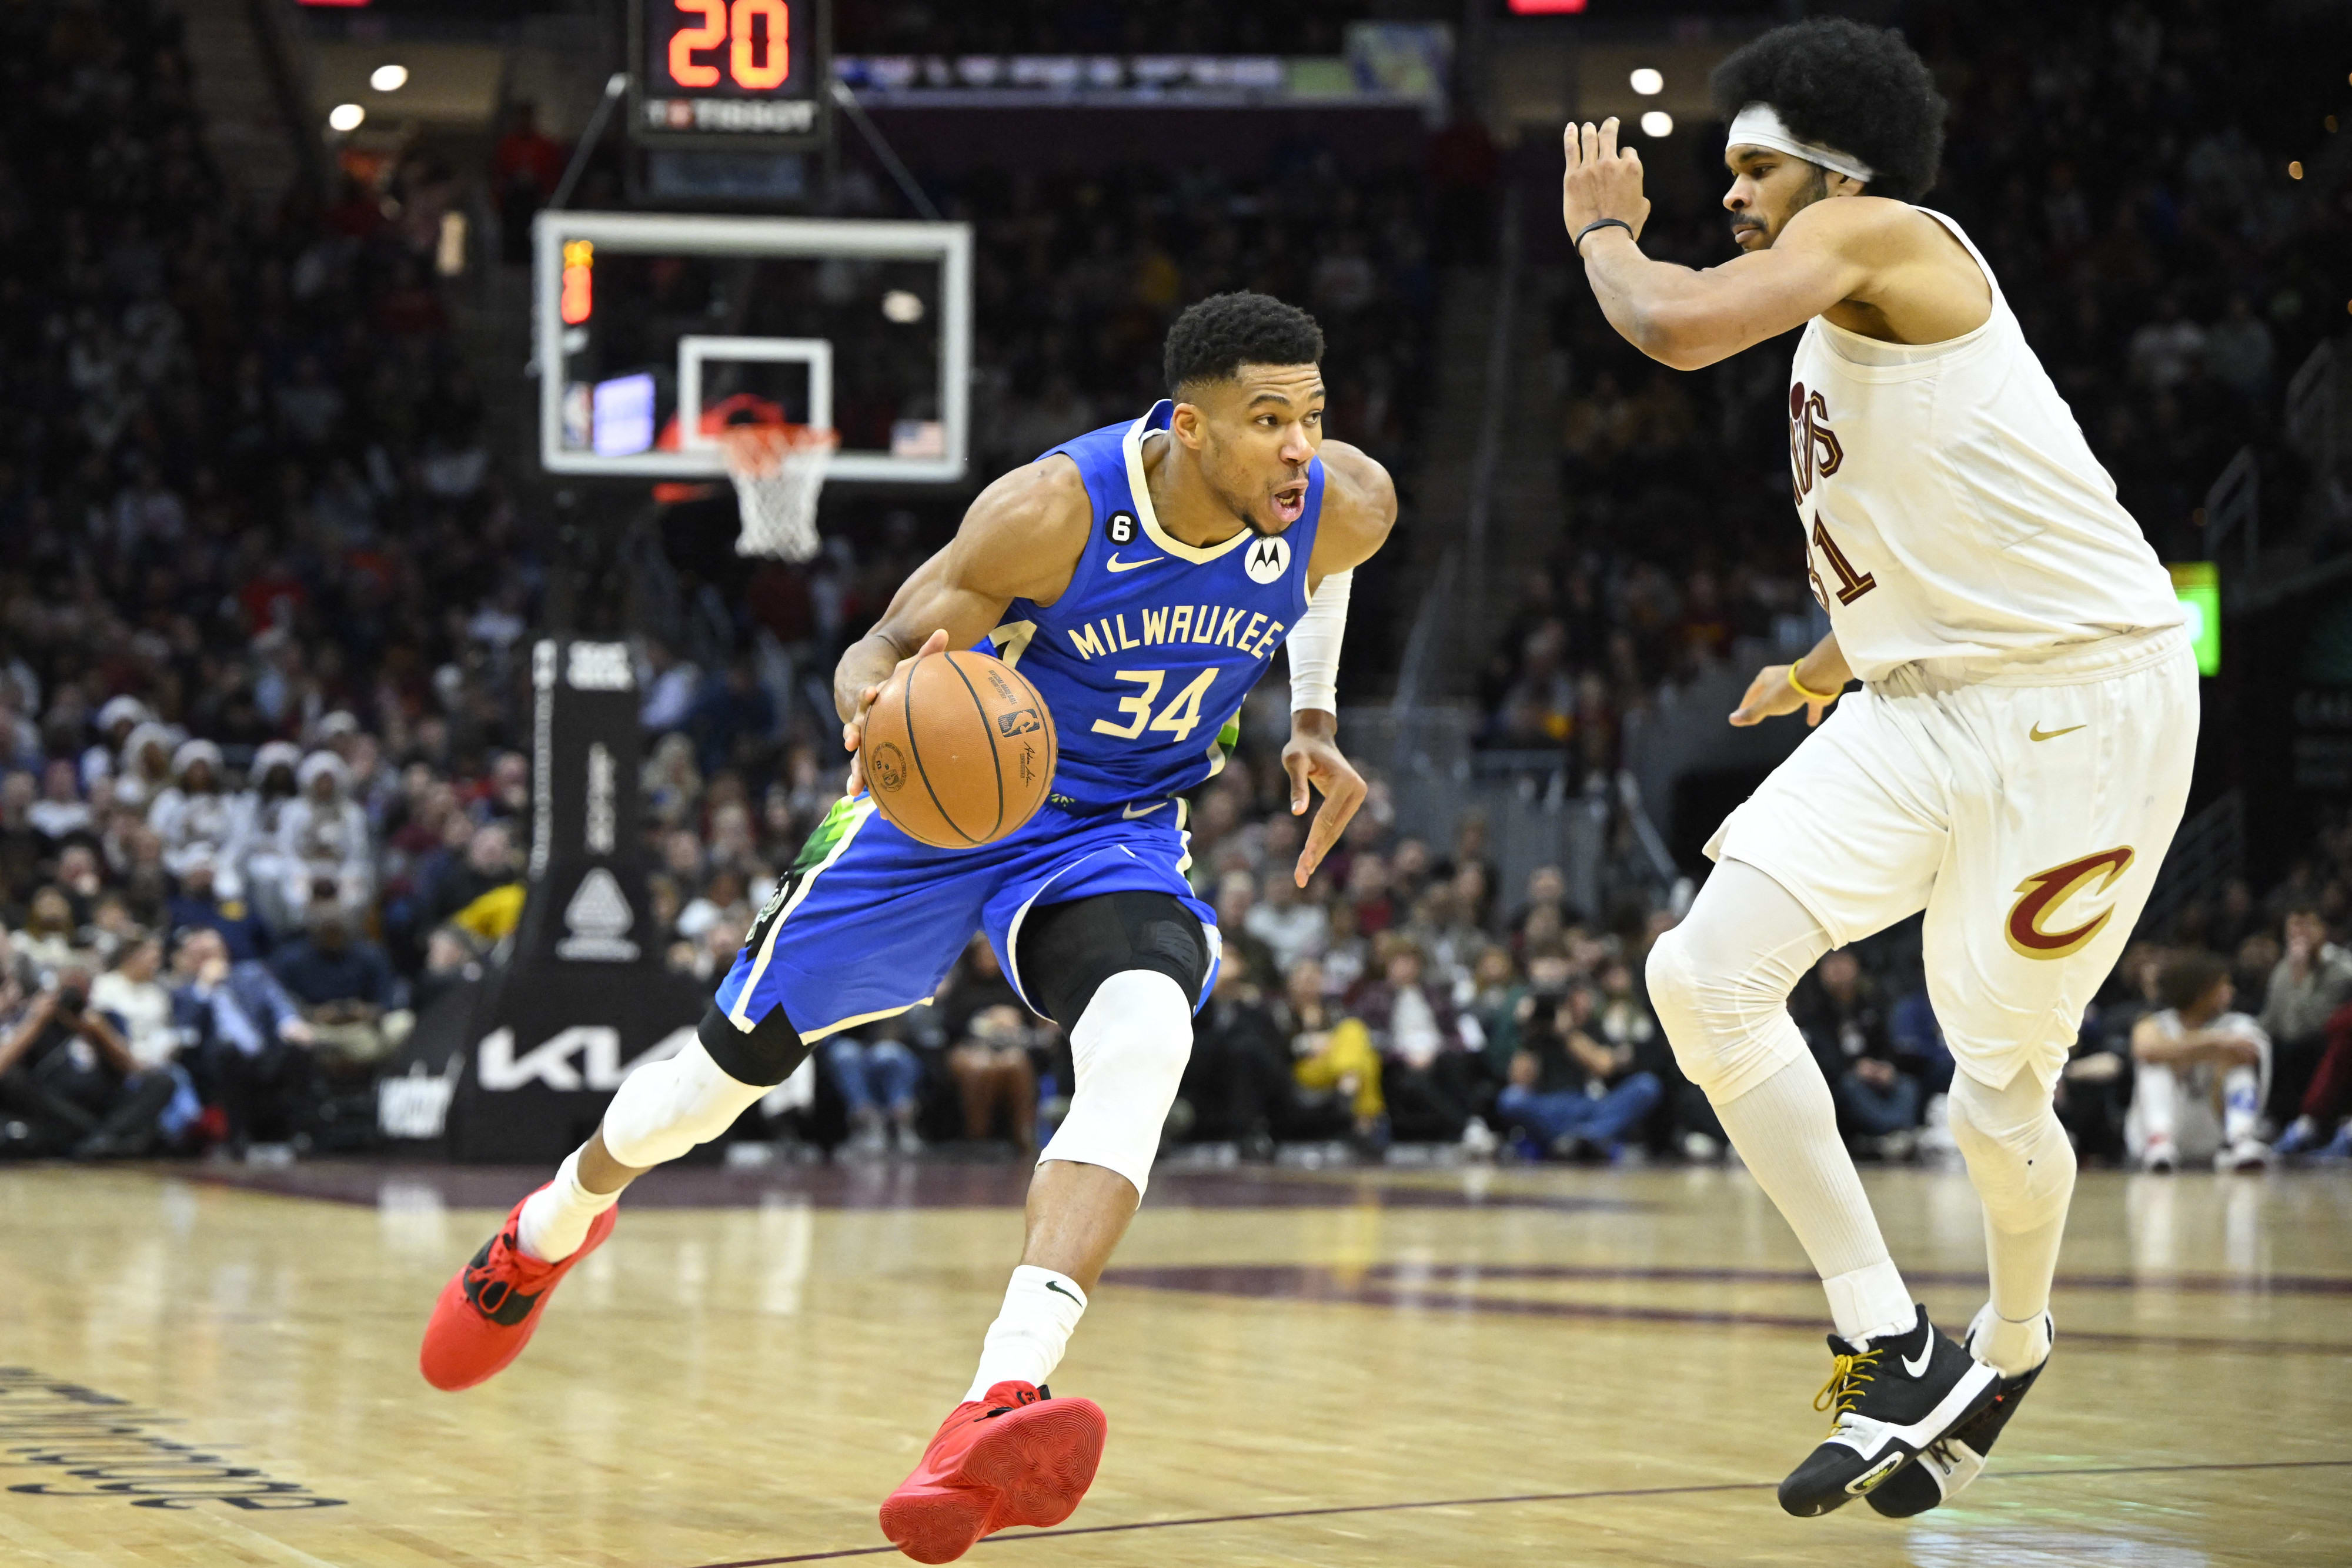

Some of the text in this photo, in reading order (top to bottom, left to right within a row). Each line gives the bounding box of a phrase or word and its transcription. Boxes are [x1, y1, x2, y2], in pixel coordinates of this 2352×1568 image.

[669, 0, 790, 89] 20
[1112, 515, 1131, 541] 6
[1067, 604, 1285, 660] MILWAUKEE
[1091, 667, 1220, 743] 34
